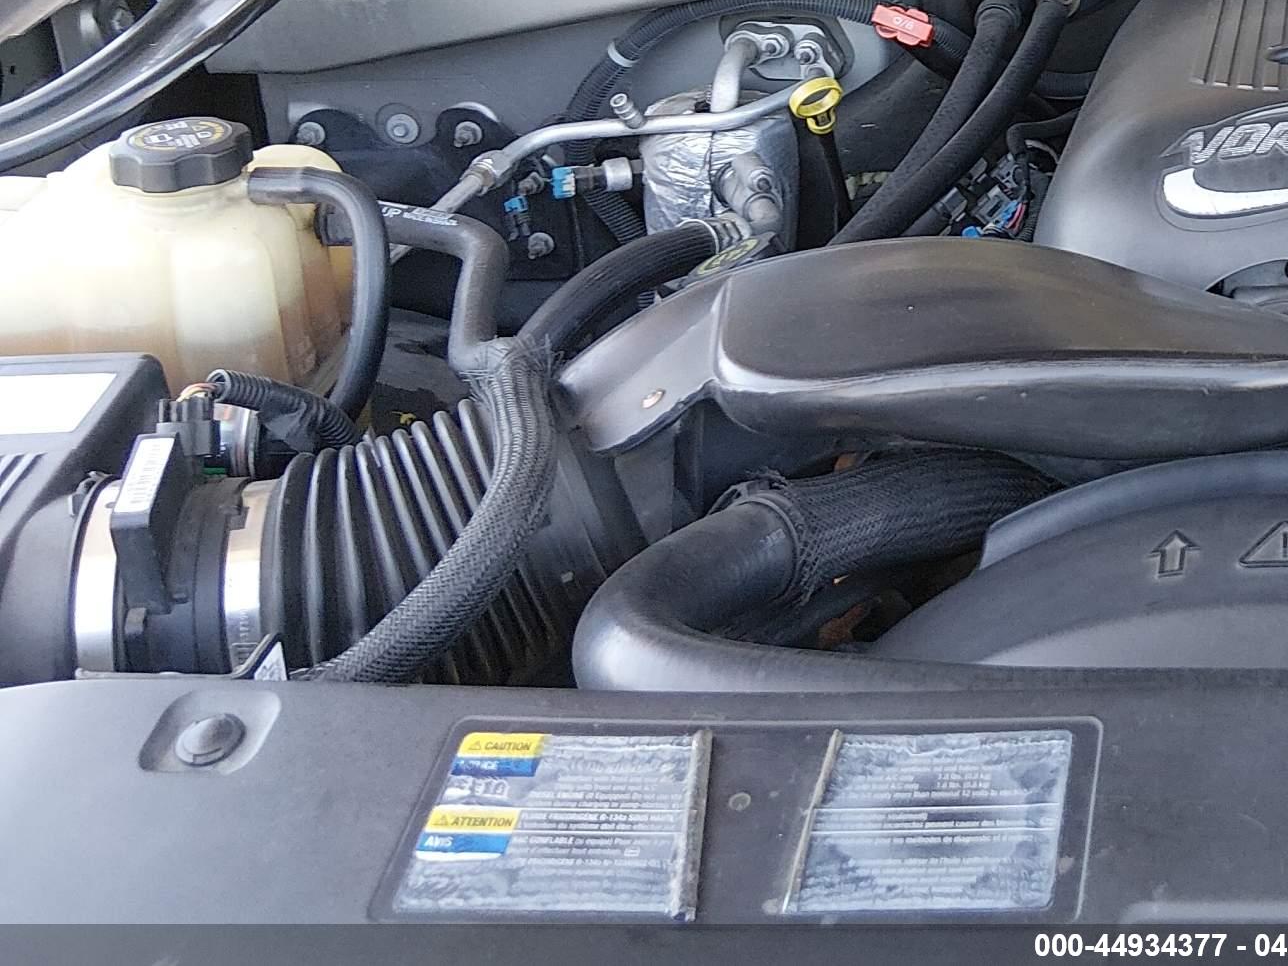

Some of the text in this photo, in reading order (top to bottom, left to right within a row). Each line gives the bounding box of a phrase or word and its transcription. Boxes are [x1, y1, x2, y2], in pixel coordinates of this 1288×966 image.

[484, 741, 533, 751] CAUTION
[450, 817, 514, 827] ATTENTION
[424, 835, 454, 847] AVIS
